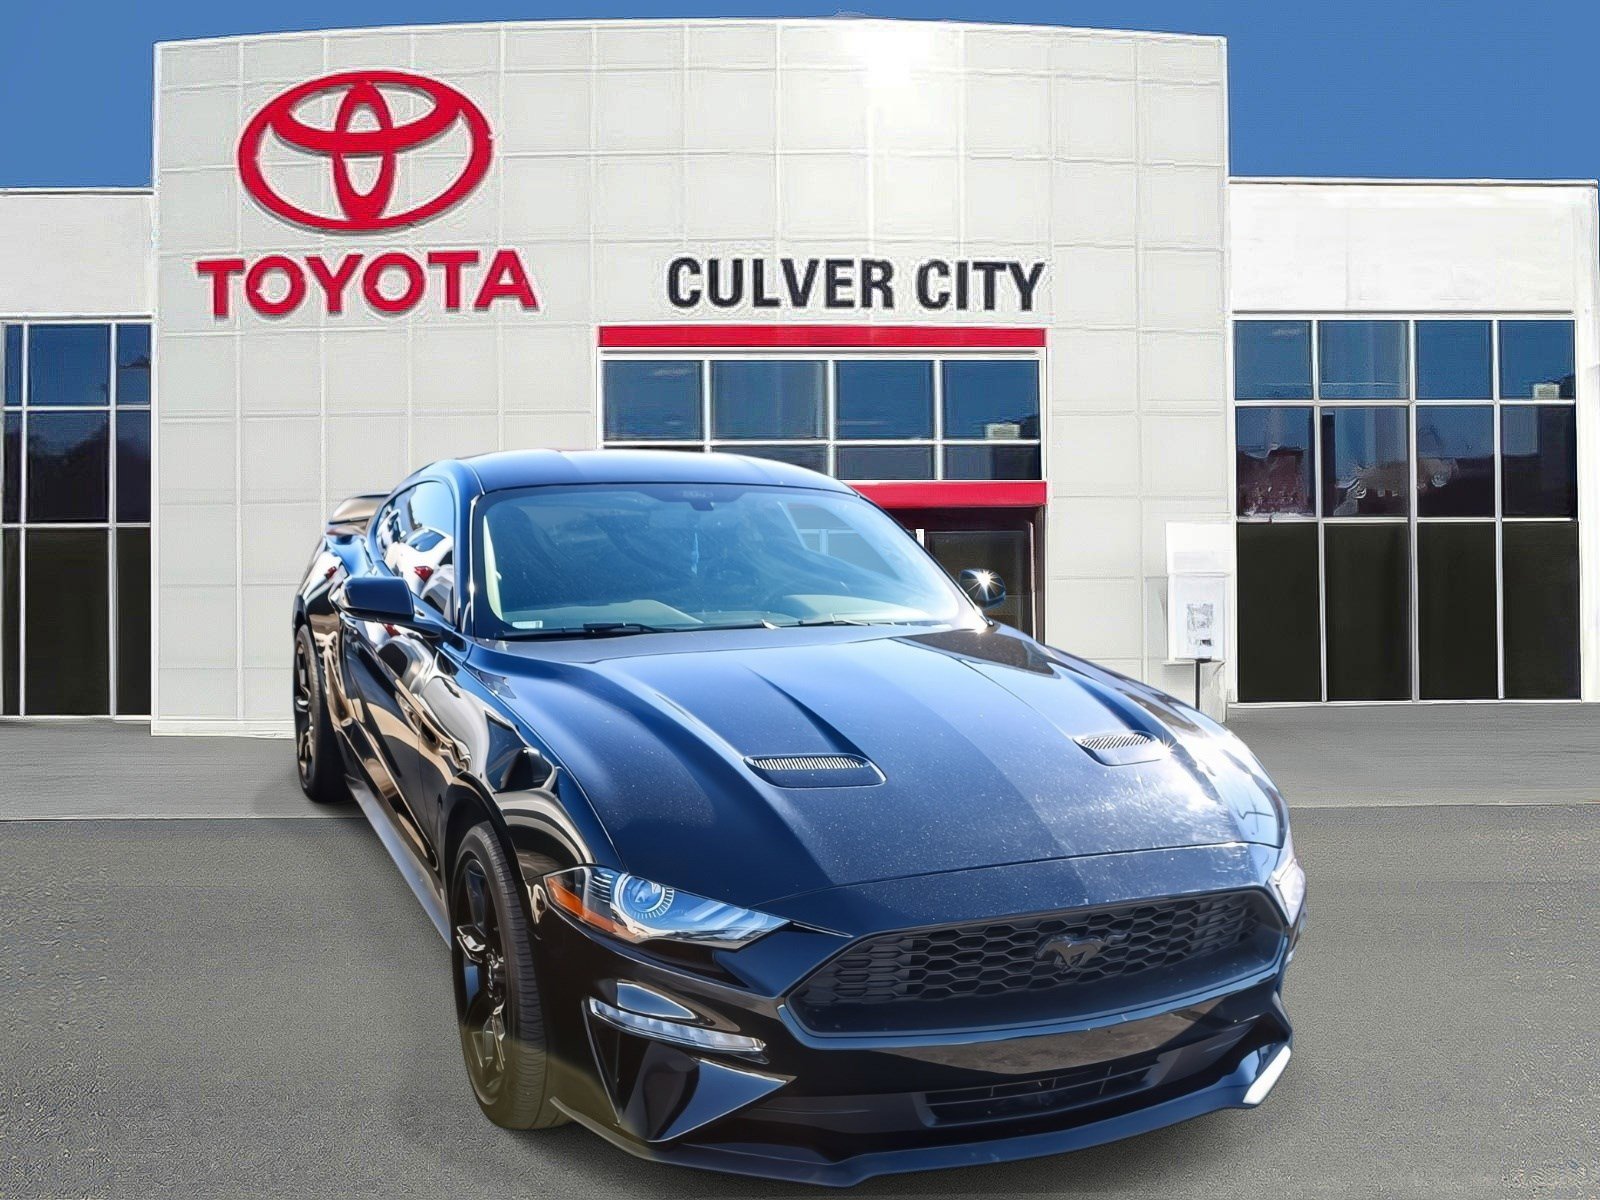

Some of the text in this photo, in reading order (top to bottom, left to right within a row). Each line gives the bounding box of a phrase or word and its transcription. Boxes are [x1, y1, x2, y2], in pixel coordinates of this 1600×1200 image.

[196, 249, 538, 316] TOYOTA
[668, 257, 1043, 311] CULVER CITY
